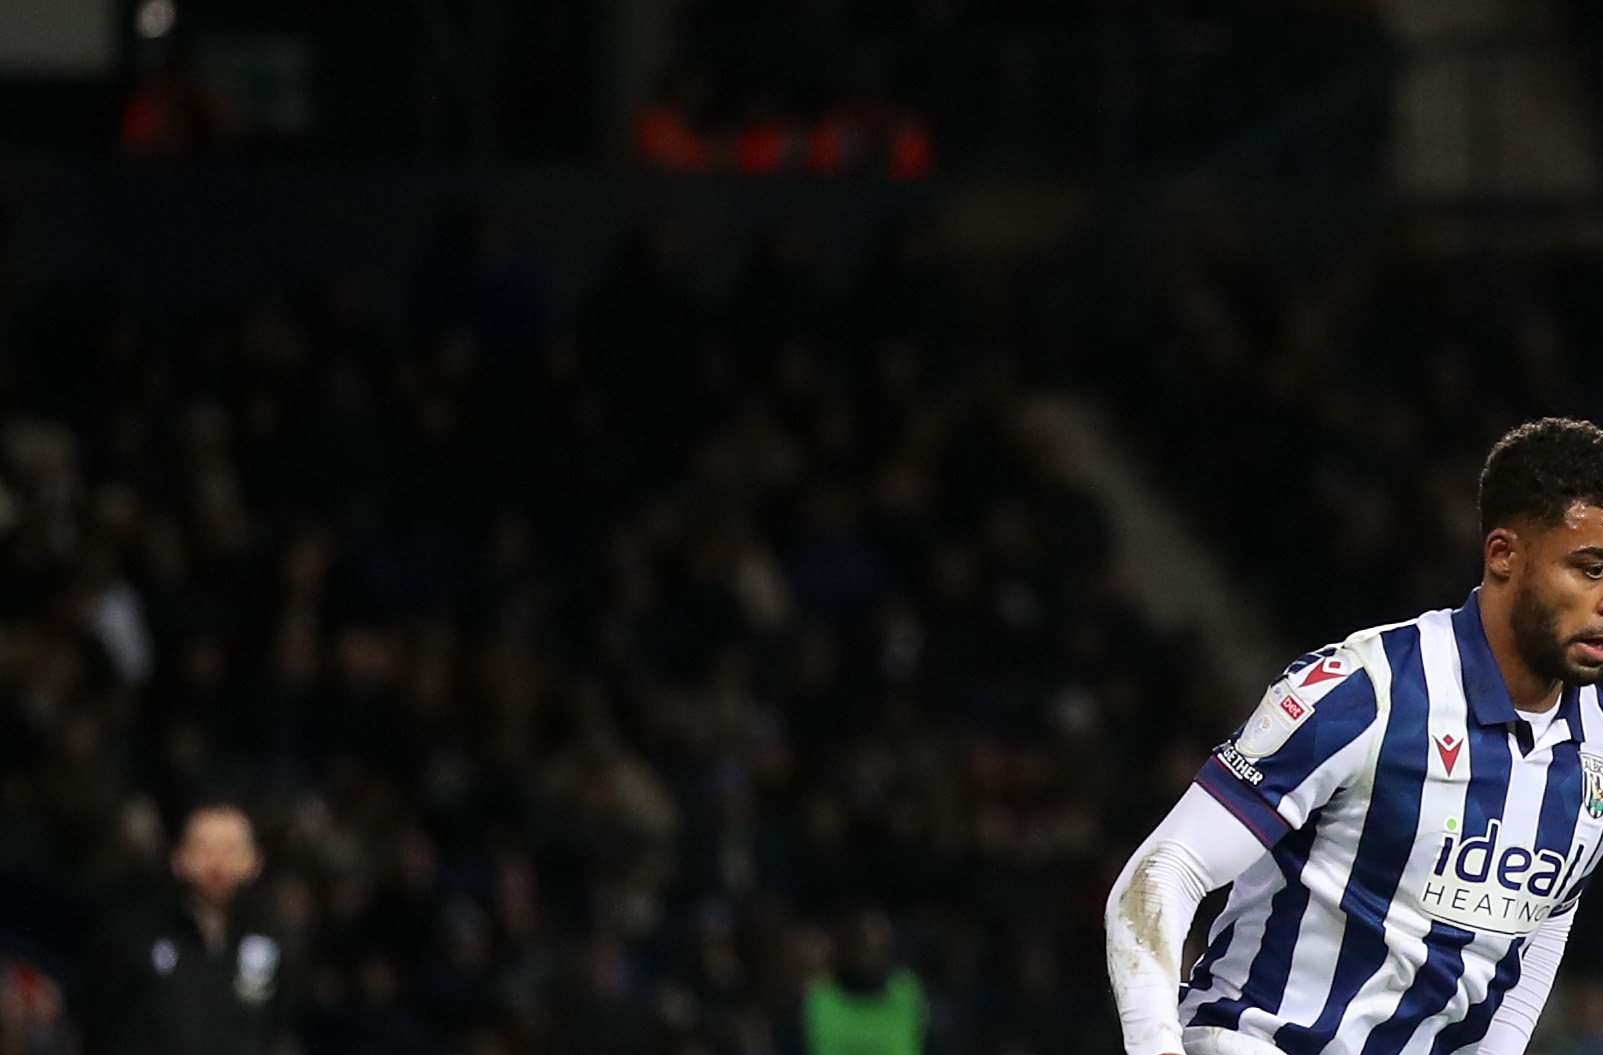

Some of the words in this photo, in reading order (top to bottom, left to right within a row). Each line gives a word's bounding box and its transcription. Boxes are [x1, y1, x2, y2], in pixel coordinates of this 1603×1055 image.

[1282, 697, 1302, 719] bet
[1213, 740, 1264, 785] GETHER
[1434, 818, 1586, 900] ideal
[1422, 882, 1551, 923] HEATNG
